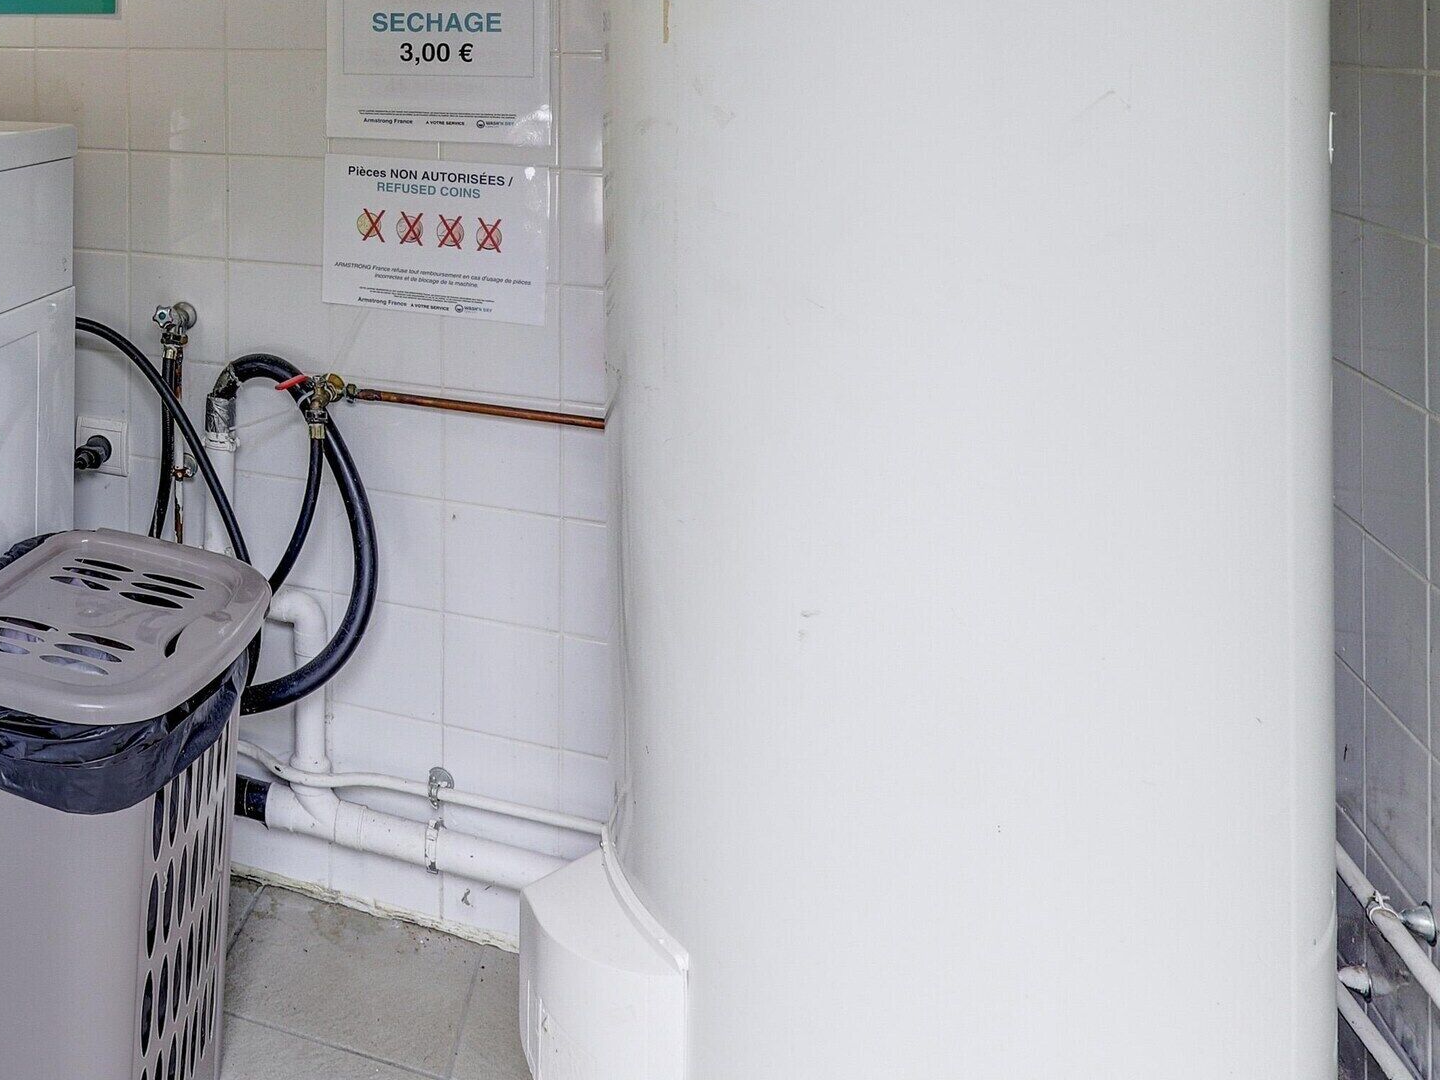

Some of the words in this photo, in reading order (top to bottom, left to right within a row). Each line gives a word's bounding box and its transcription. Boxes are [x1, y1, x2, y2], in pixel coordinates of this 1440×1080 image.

[372, 11, 502, 33] SECHAGE
[399, 43, 451, 66] 3,00
[458, 43, 473, 63] €
[348, 166, 386, 178] Pièces
[390, 169, 417, 180] NON
[421, 171, 505, 186] AUTORISÉES
[508, 176, 513, 187] /
[376, 181, 436, 196] REFUSED
[440, 186, 481, 199] COINS
[334, 261, 371, 270] ARMSTRONG
[420, 270, 461, 279] remboursement
[418, 277, 439, 285] blocage
[358, 296, 386, 305] Armstrong
